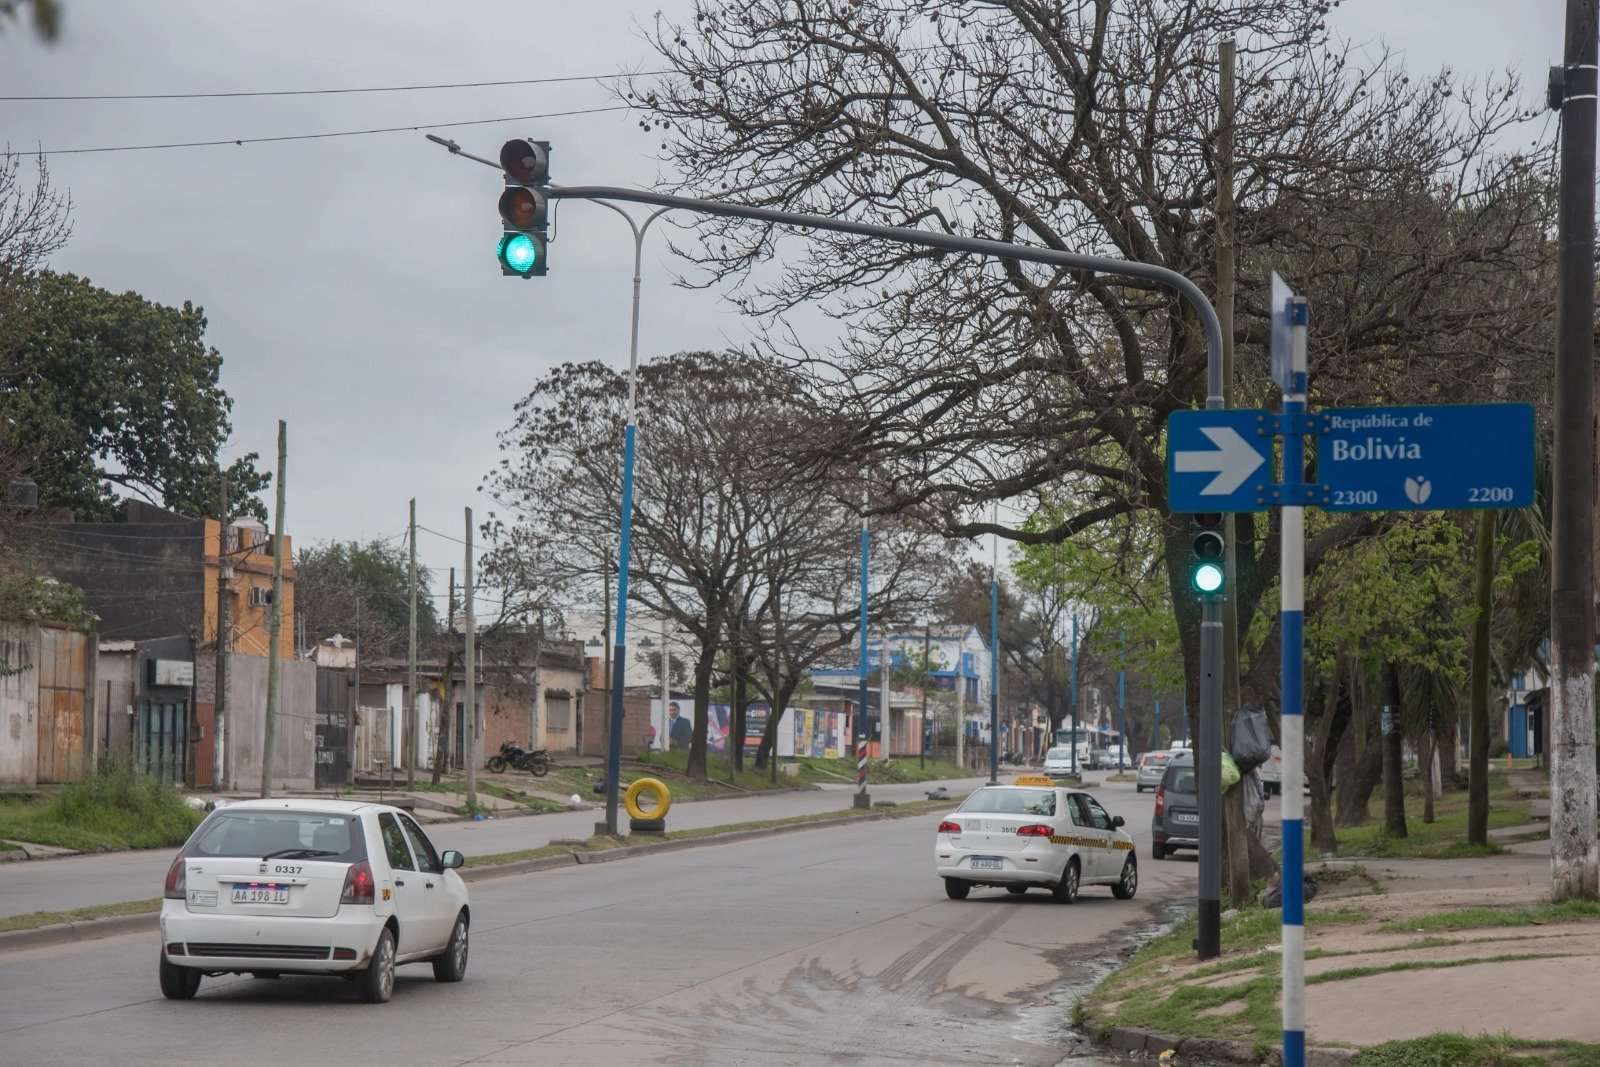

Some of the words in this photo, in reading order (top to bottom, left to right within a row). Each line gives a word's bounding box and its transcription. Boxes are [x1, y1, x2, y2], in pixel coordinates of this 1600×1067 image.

[1332, 414, 1408, 432] República
[1413, 412, 1433, 426] de
[1333, 437, 1421, 460] Bolivia
[1333, 490, 1377, 505] 2300
[1468, 487, 1513, 502] 2200
[275, 865, 302, 875] 0337
[234, 890, 247, 901] AA
[250, 890, 270, 901] 198
[274, 891, 286, 901] IL
